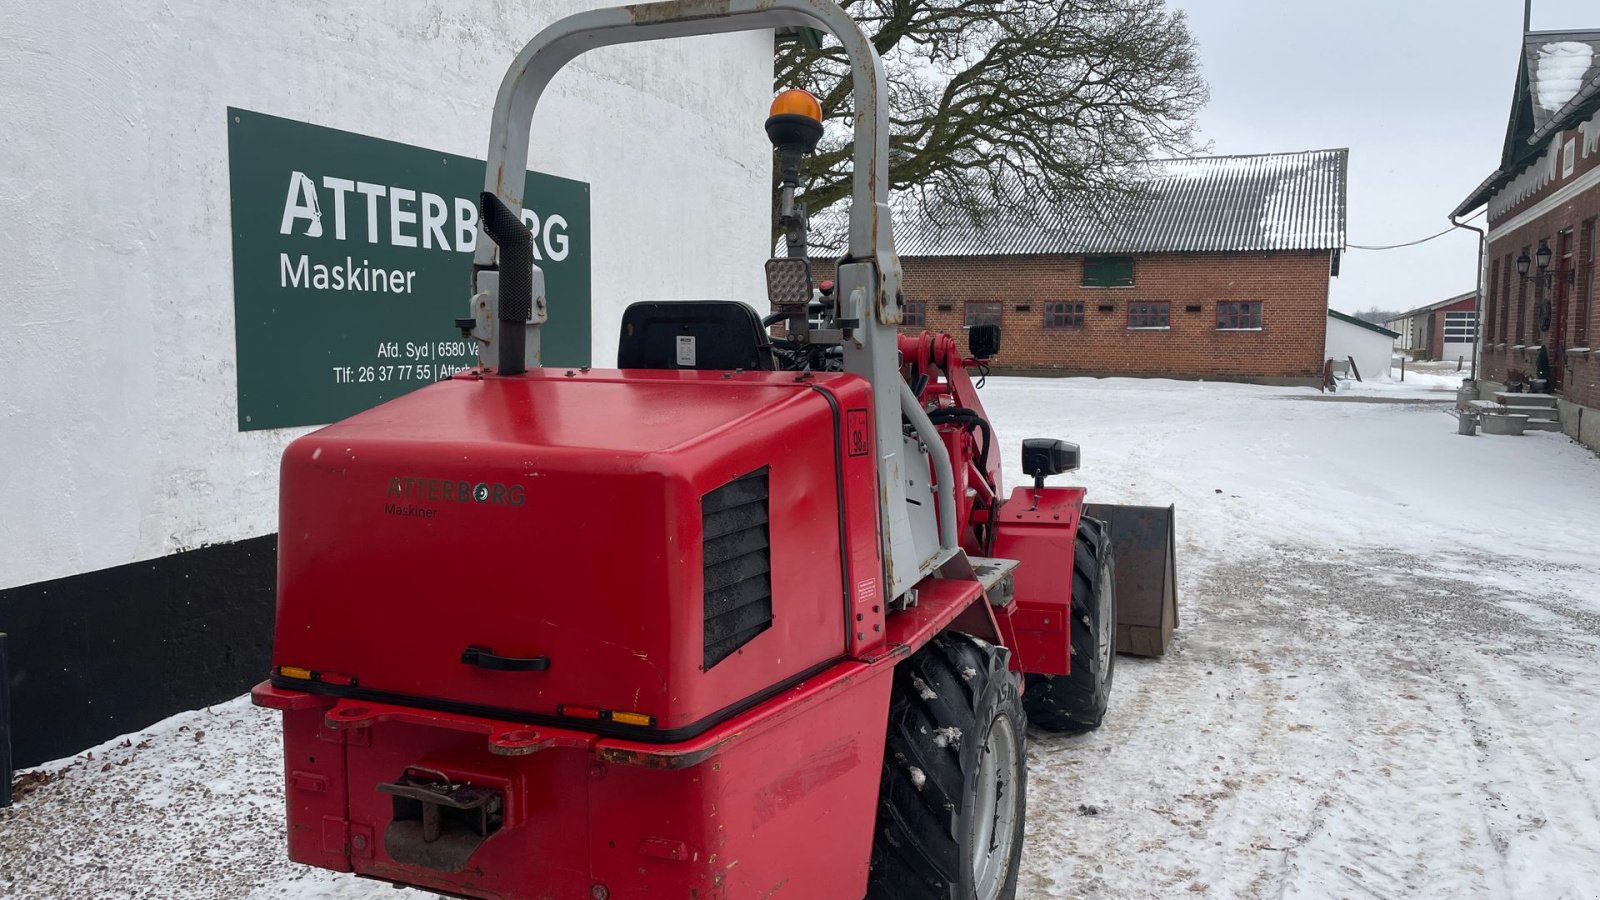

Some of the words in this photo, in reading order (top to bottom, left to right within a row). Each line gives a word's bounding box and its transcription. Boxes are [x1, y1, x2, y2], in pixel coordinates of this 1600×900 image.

[280, 171, 569, 262] ATTERBRG
[280, 252, 416, 294] Maskiner
[377, 342, 402, 358] Afd.
[406, 341, 429, 361] Syd
[438, 341, 466, 357] 6580
[358, 366, 375, 383] 26
[378, 365, 394, 381] 37
[398, 364, 413, 381] 77
[416, 364, 431, 380] 55
[386, 475, 526, 507] ATTERBORG
[385, 503, 438, 519] Maskiner
